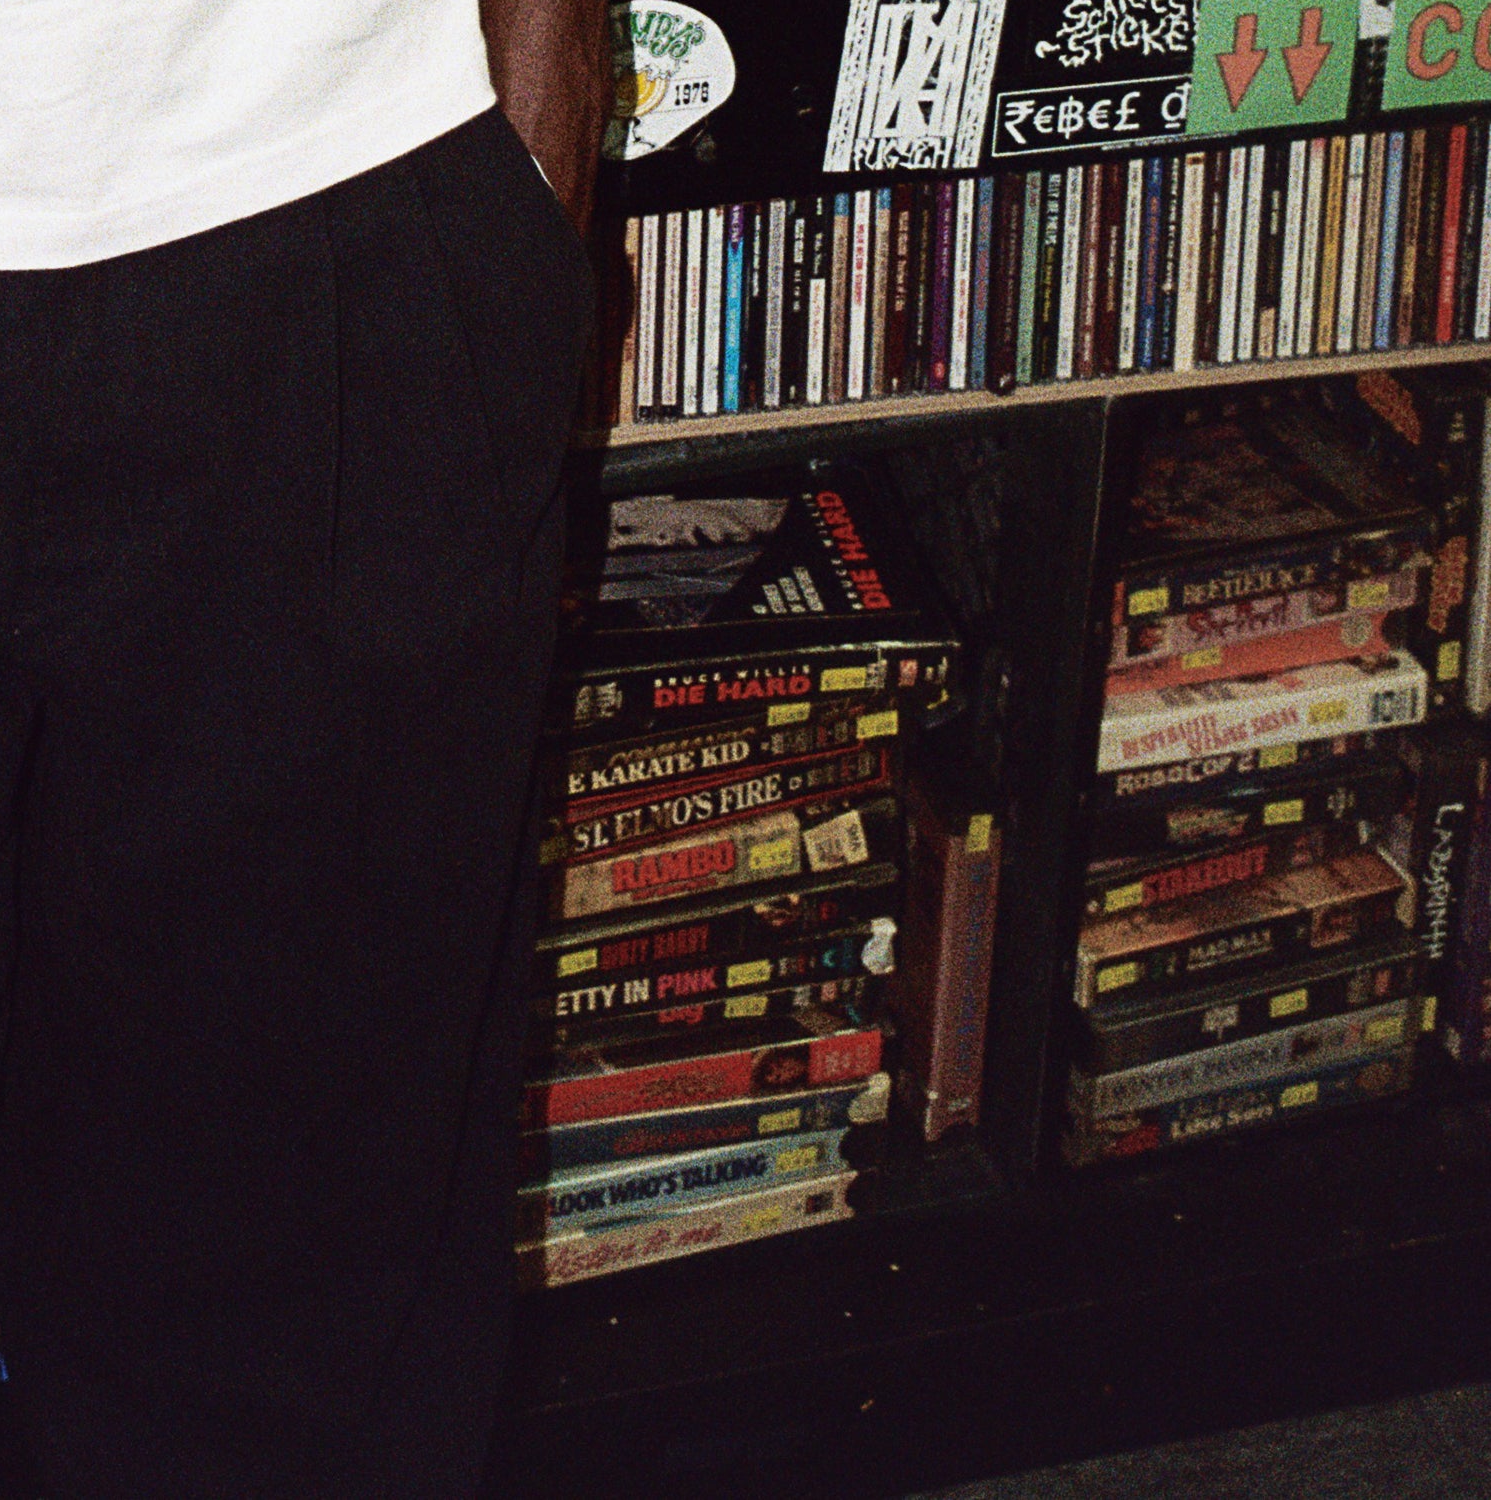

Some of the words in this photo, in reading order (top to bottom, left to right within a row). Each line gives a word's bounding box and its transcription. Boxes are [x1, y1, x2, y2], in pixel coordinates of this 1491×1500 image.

[1059, 14, 1193, 67] STICKE
[817, 490, 868, 562] HARD
[848, 568, 891, 609] DIE
[653, 665, 720, 687] BRUCE
[653, 684, 705, 708] DIE
[717, 675, 811, 702] HARD
[590, 752, 696, 790] KARATE
[700, 740, 750, 767] KID
[718, 773, 782, 815] FIRE
[612, 840, 736, 894] RAMBO
[556, 982, 617, 1016] ETTY
[623, 978, 649, 1005] IN
[656, 966, 718, 998] PINK
[608, 1171, 677, 1204] WHO'S
[681, 1154, 767, 1192] TALKING
